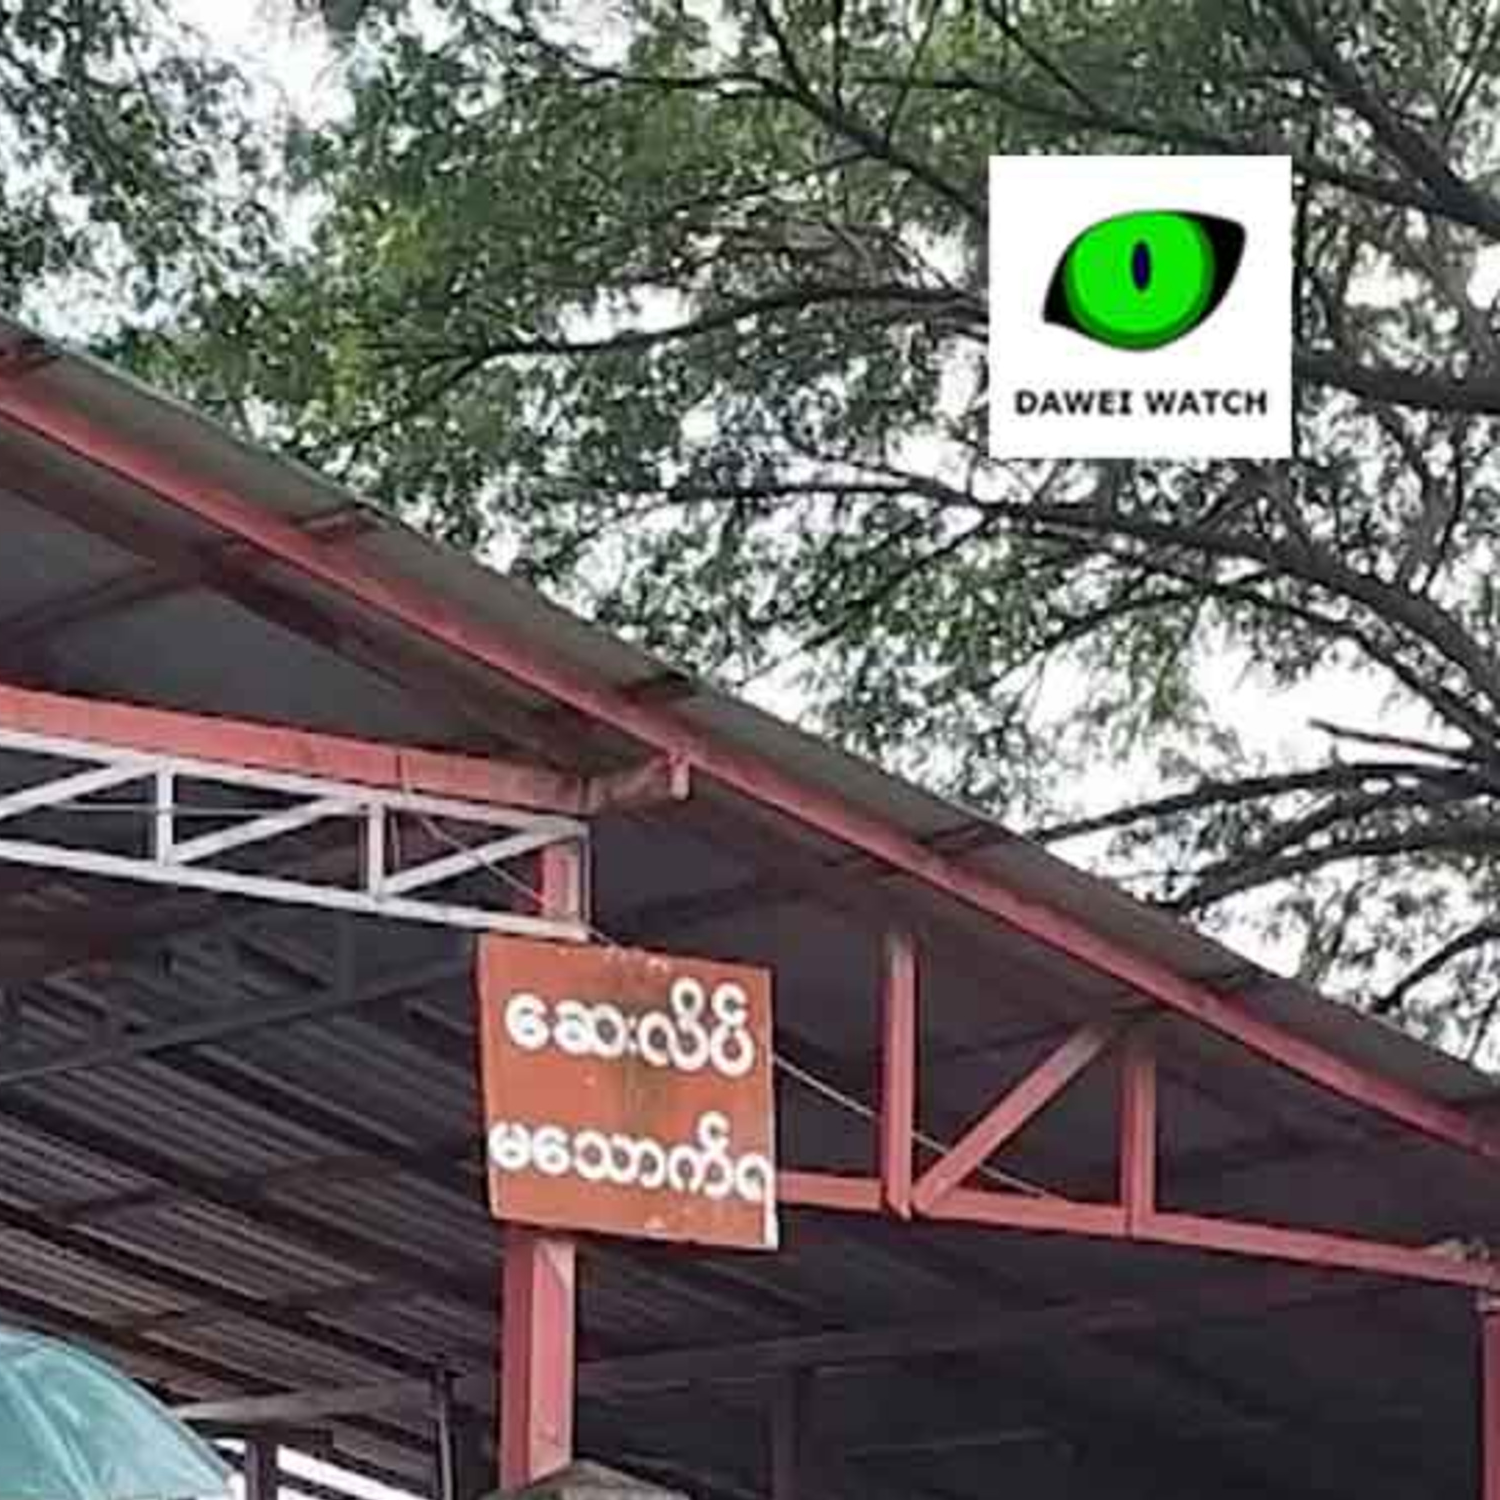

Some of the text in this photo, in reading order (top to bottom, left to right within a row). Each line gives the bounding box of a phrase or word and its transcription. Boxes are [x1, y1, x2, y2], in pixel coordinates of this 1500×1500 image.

[505, 976, 754, 1077] ဆေးလိပ်
[488, 1111, 779, 1248] မသောက်ရ
